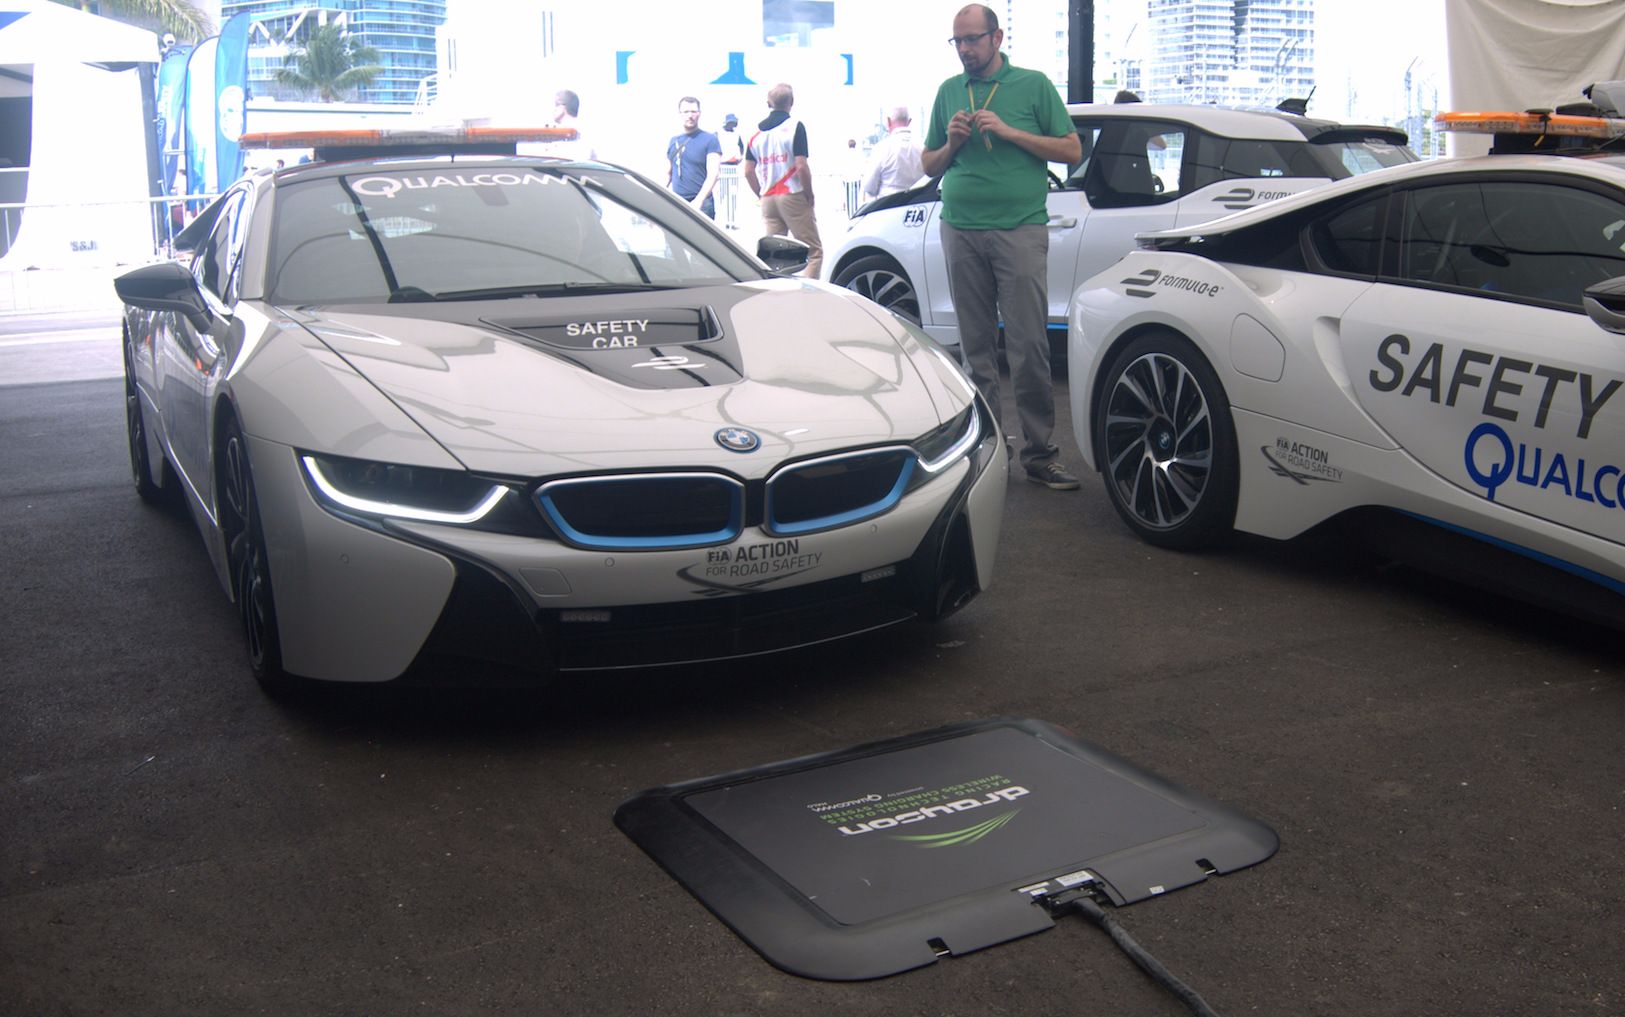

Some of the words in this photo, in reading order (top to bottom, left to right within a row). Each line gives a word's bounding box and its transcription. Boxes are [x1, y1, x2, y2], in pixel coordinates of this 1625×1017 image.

[352, 174, 603, 198] QUALCOMM
[566, 319, 649, 336] SAFETY
[592, 335, 639, 349] CAR
[1369, 334, 1624, 440] SAFETY
[1291, 441, 1329, 464] ACTION
[1287, 454, 1311, 470] ROAD
[1311, 461, 1344, 480] SAFETY
[1464, 422, 1625, 510] QUALC
[735, 539, 799, 562] ACTION
[706, 566, 728, 576] FOR
[730, 561, 769, 577] ROAD
[772, 552, 823, 573] SAFETY
[837, 785, 1031, 835] drayson
